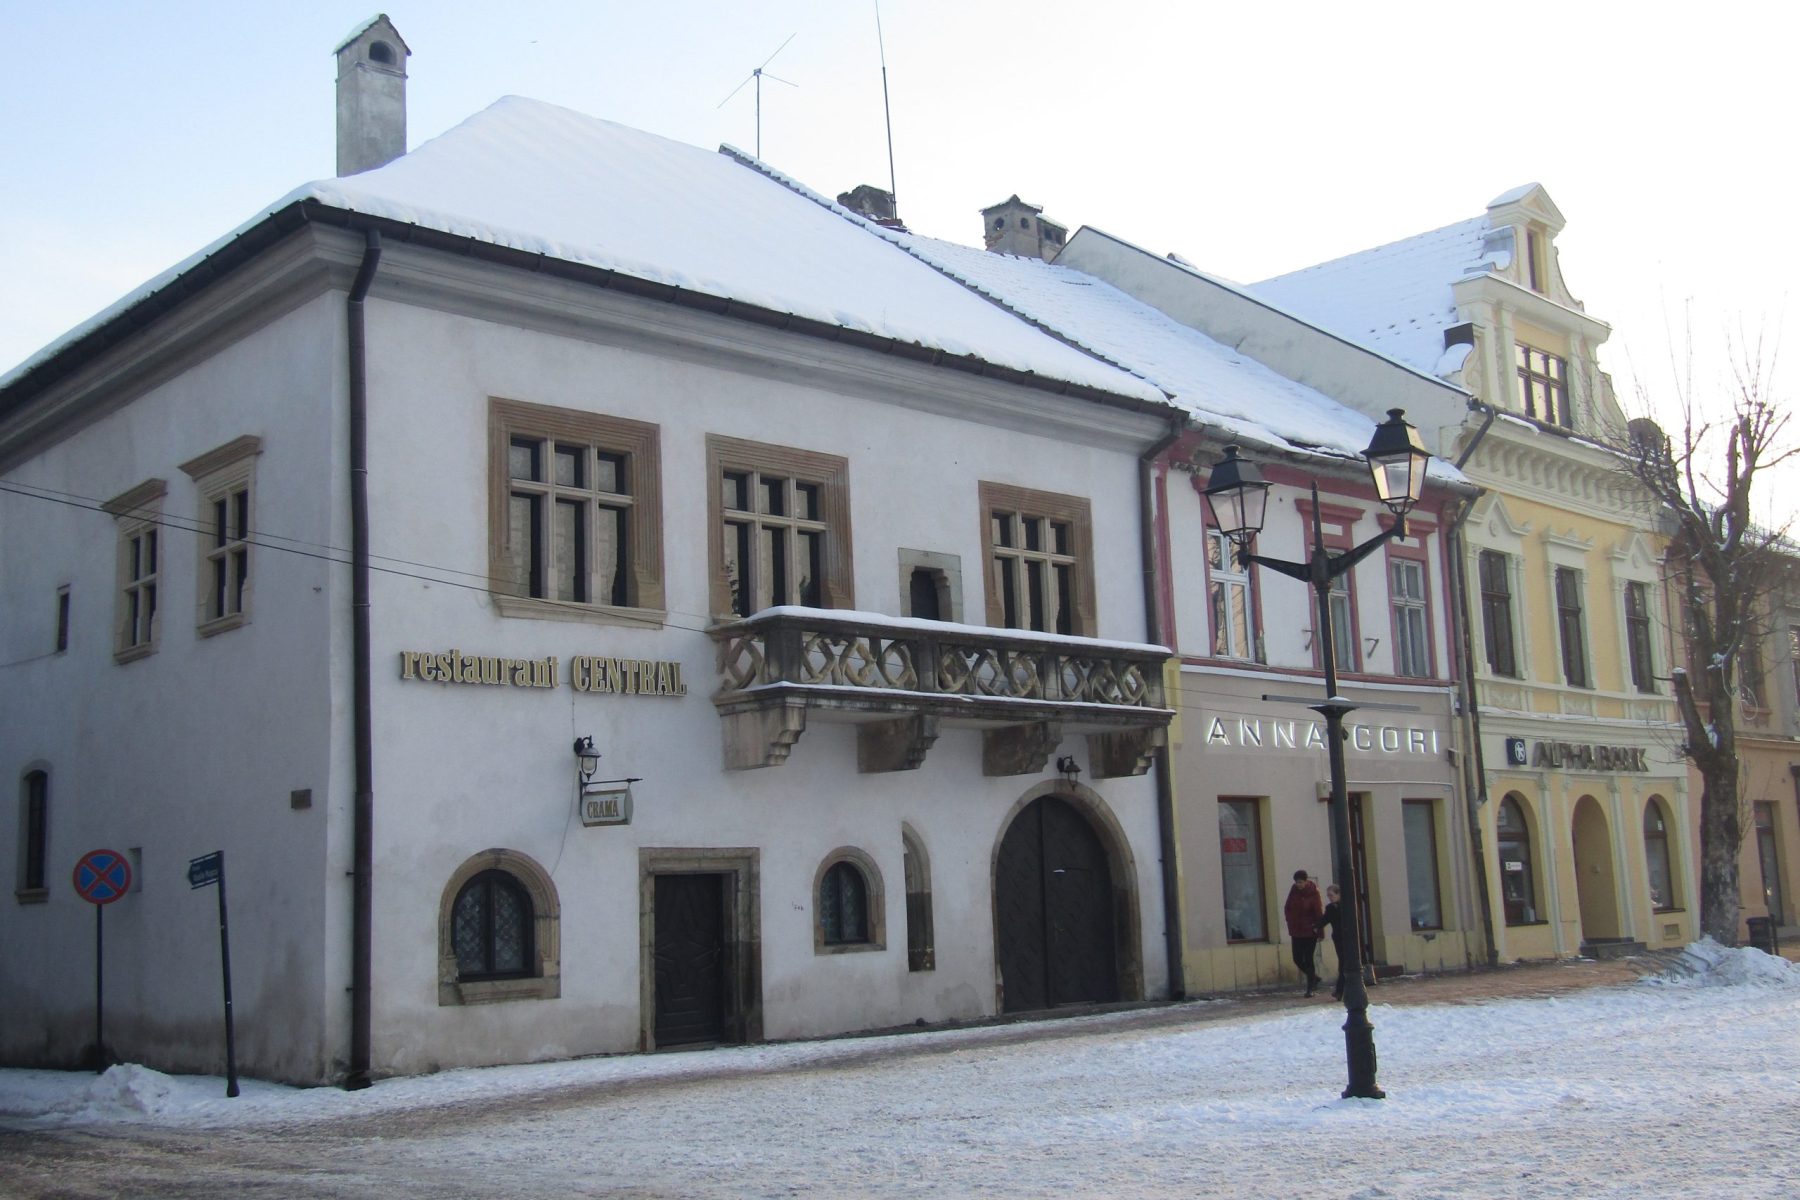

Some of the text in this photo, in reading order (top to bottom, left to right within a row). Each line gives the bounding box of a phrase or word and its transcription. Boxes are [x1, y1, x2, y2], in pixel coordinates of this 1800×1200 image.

[400, 649, 687, 697] restaurant CENTRAL
[1207, 717, 1438, 754] ANNA CORI
[1594, 745, 1649, 772] BANK
